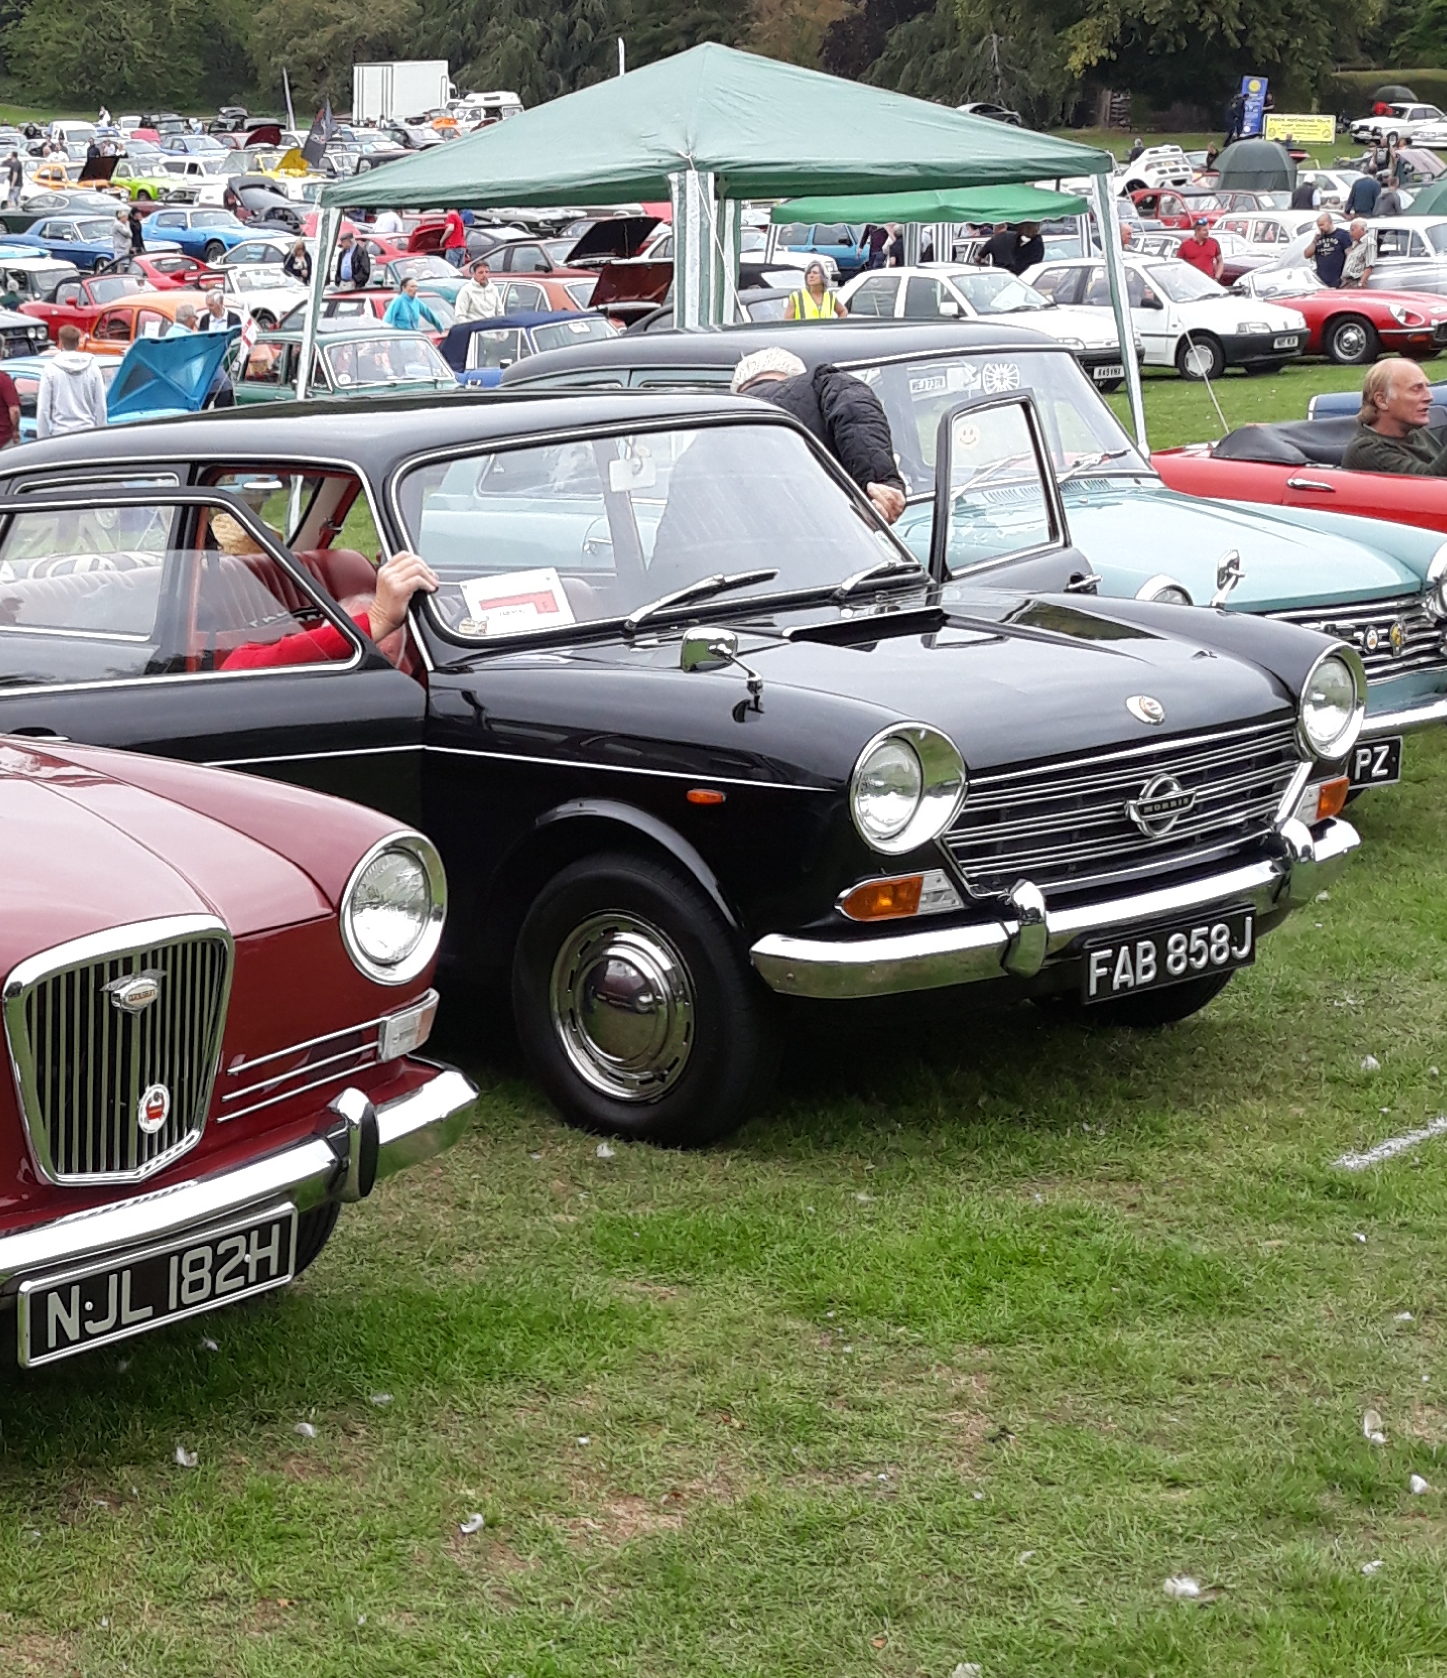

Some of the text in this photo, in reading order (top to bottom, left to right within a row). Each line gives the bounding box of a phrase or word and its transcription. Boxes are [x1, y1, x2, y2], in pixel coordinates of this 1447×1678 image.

[1143, 797, 1189, 814] MORRIS
[1089, 916, 1253, 996] FAB 858J
[47, 1223, 281, 1349] NJL 182H
